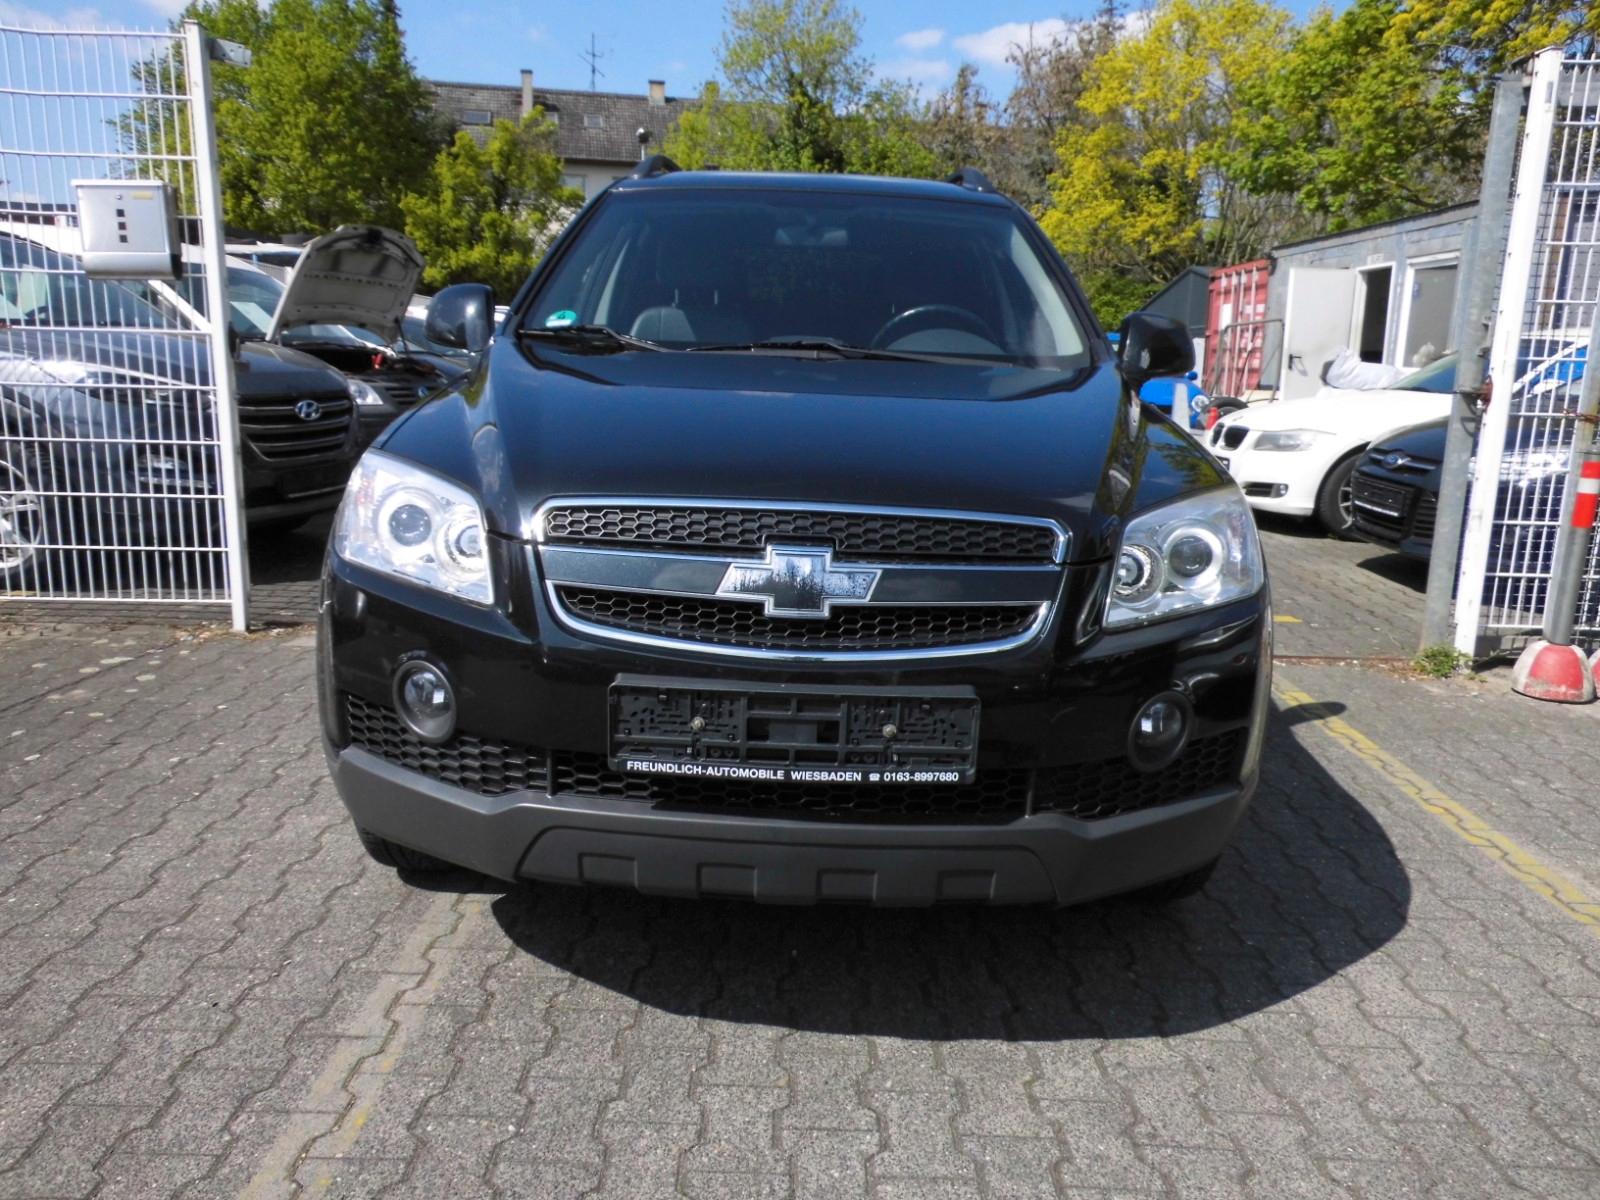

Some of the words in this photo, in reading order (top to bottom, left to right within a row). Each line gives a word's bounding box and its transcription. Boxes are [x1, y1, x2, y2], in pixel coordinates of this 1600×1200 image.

[626, 761, 785, 780] FREUNDLICH-AUTOMOBILE
[791, 770, 862, 782] WIESBADEN
[883, 771, 960, 782] 0163-8997680
